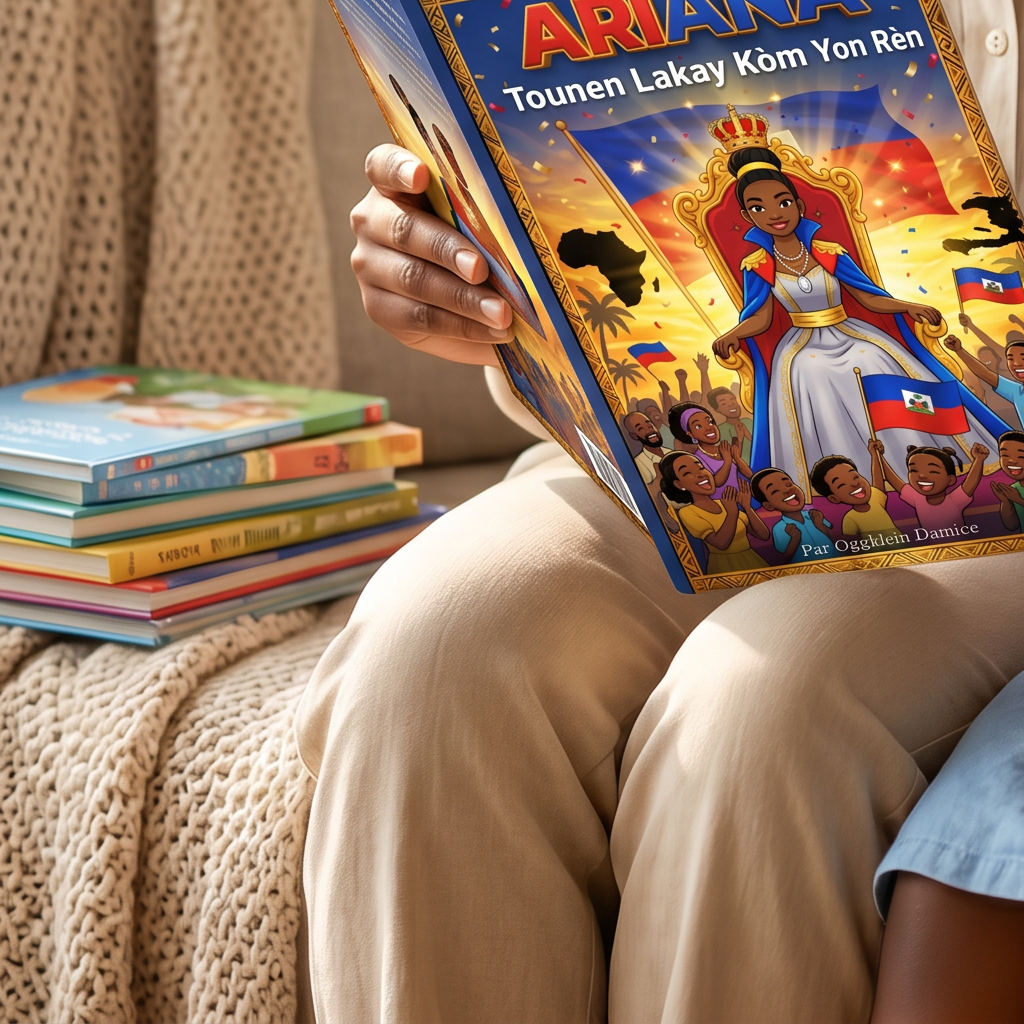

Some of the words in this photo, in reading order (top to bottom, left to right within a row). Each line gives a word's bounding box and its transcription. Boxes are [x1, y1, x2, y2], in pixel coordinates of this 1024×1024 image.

[503, 74, 626, 112] Tounen
[630, 59, 725, 93] Lakay
[732, 47, 807, 76] Kòm
[810, 36, 867, 63] Yon
[871, 26, 925, 54] Rèn
[801, 543, 829, 557] Par
